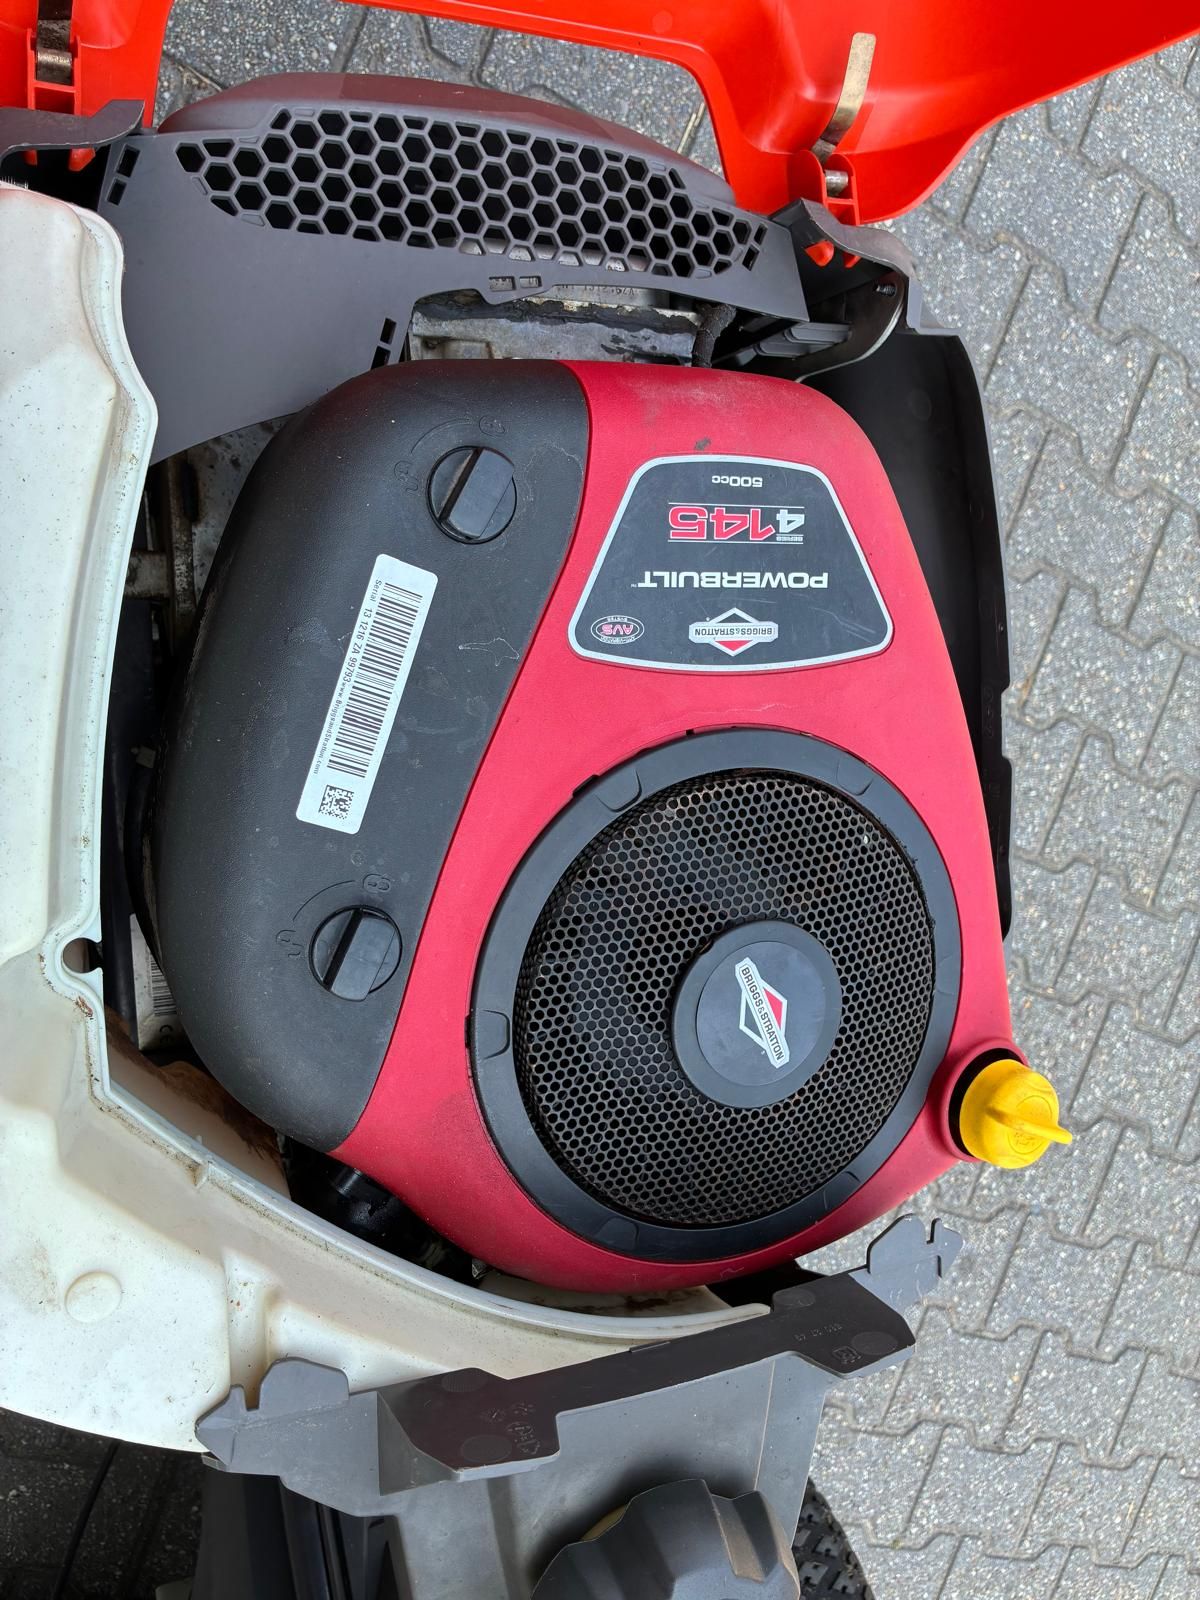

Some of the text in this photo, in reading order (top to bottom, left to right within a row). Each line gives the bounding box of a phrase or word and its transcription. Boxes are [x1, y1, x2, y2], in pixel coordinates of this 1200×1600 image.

[711, 475, 763, 488] 500cc
[637, 571, 828, 588] POWERBUILT
[369, 579, 382, 602] Serial
[363, 607, 373, 618] 13
[356, 621, 369, 641] 1216
[601, 623, 634, 635] AVS
[694, 626, 773, 637] BRIGGS&STRATTON
[351, 642, 363, 654] ZA
[343, 657, 358, 683] 99793
[741, 966, 785, 1061] BRIGGS&STRATTON
